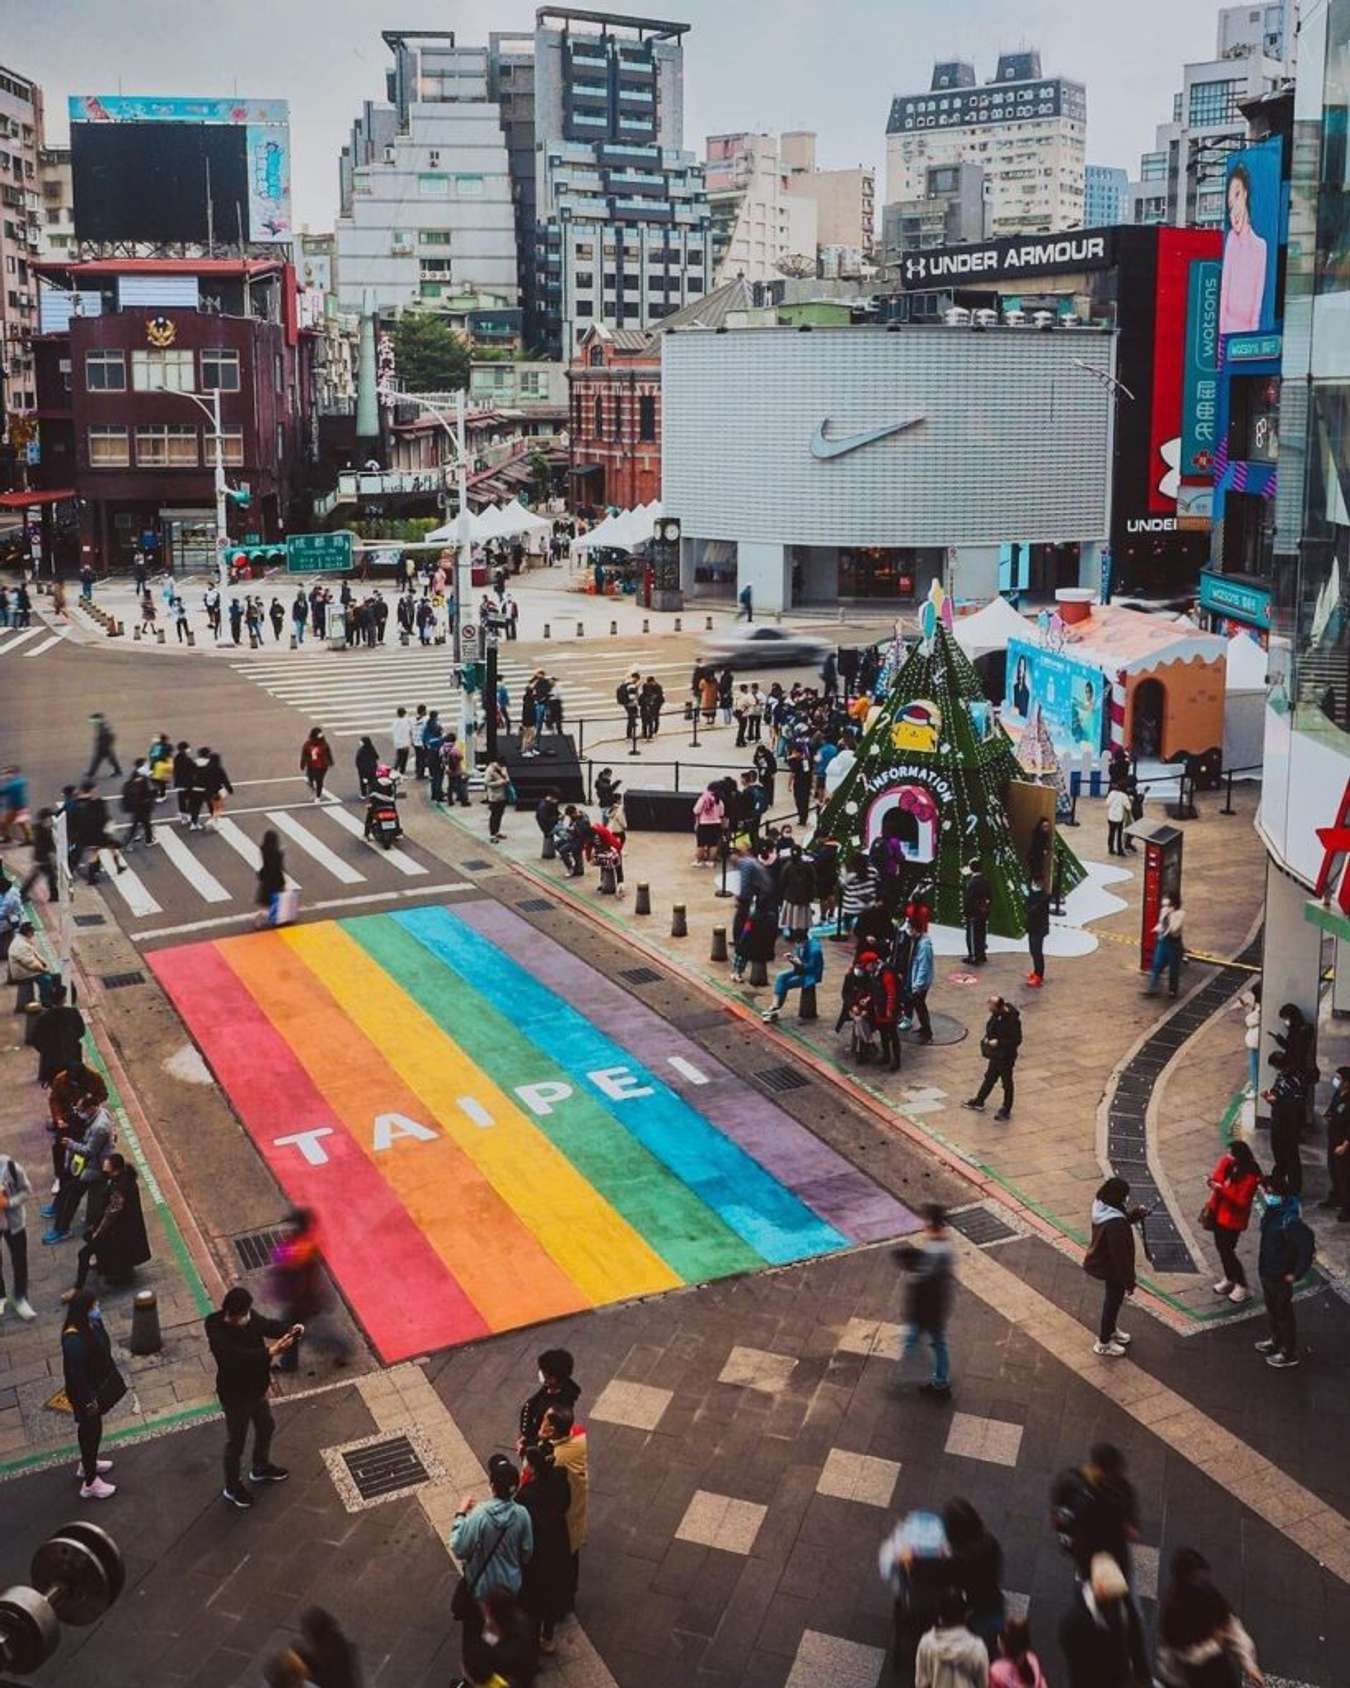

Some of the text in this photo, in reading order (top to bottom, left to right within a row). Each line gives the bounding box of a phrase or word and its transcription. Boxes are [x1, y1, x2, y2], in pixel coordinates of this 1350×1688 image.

[930, 237, 1104, 275] UNDER ARMOUR
[1202, 278, 1218, 358] watsons
[867, 765, 953, 803] INFORMATION
[273, 1056, 711, 1166] TAIPEI
